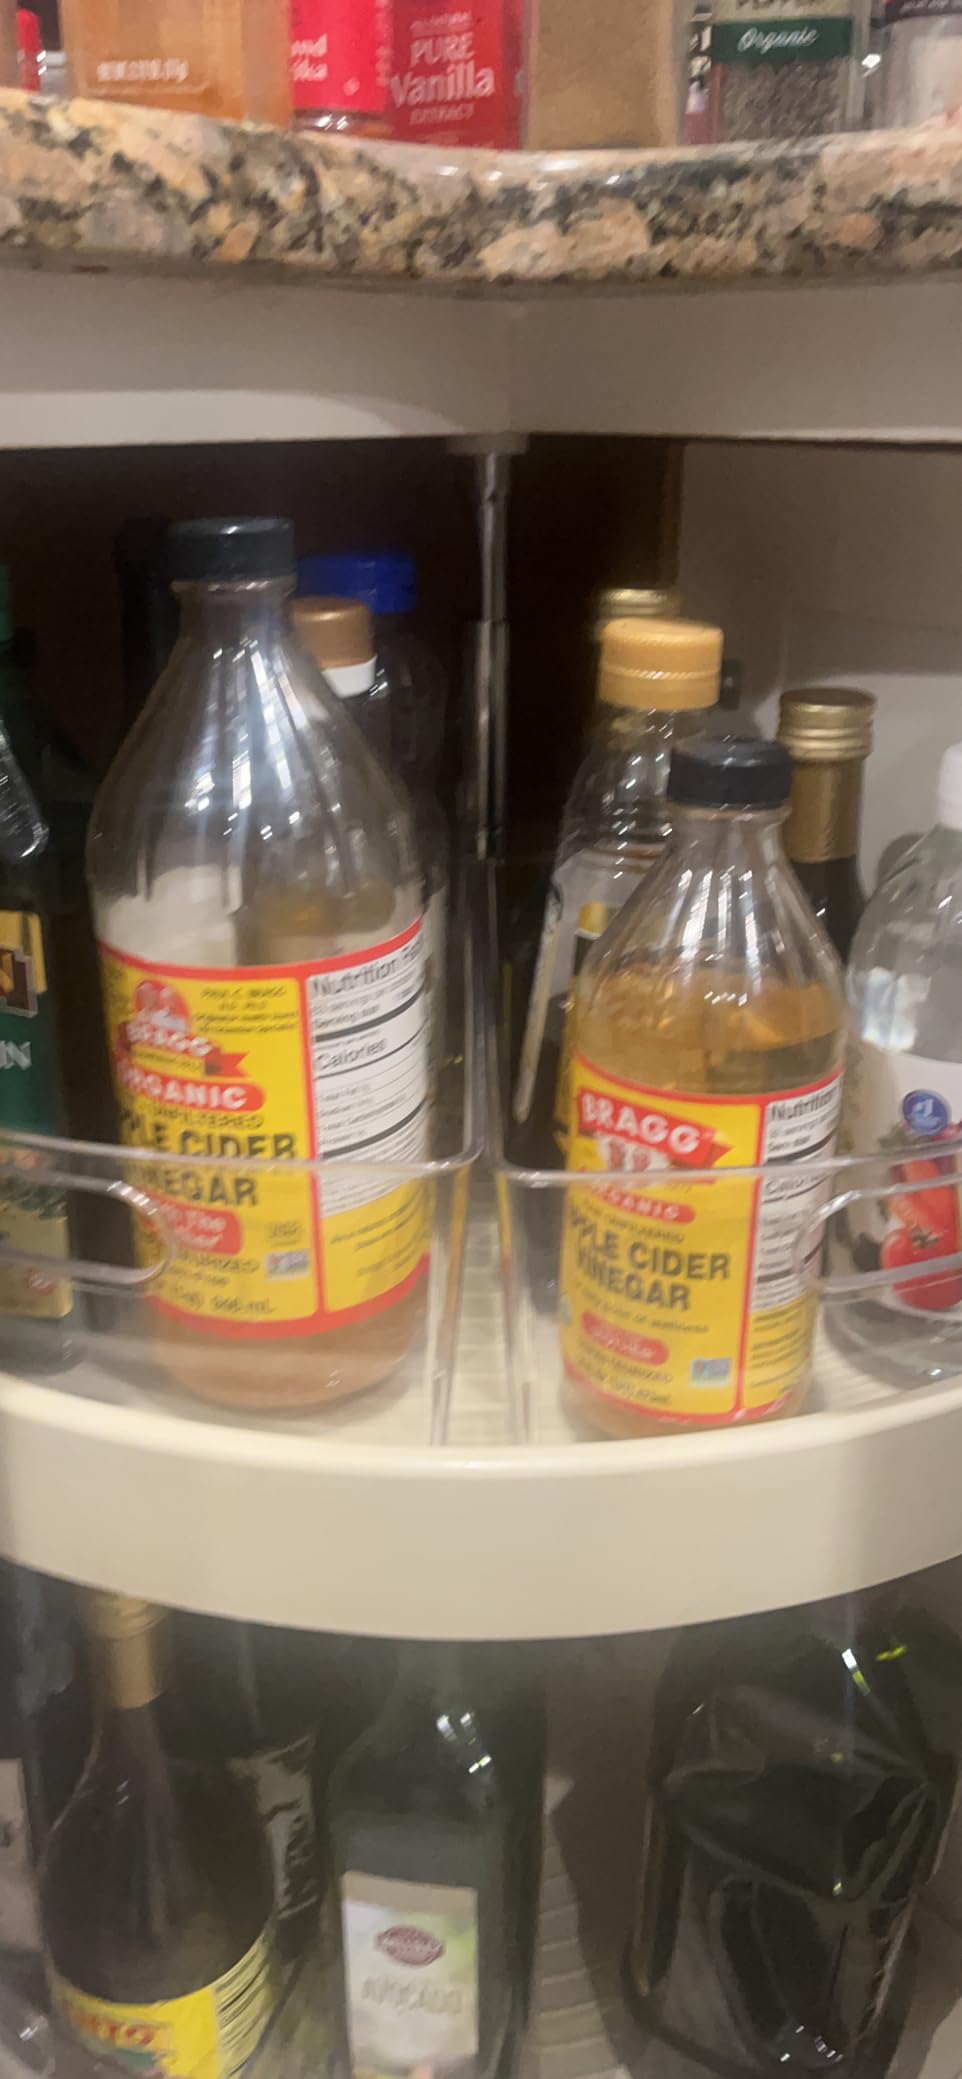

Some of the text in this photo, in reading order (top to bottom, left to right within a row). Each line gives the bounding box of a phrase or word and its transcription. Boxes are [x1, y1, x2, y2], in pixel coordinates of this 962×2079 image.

[410, 32, 474, 68] PURE
[737, 27, 818, 54] Organic
[390, 60, 495, 108] Vanilla
[312, 957, 396, 996] Nutrition
[318, 1038, 386, 1071] Calories
[580, 1093, 701, 1154] BRAGG
[178, 1129, 297, 1159] CIDER
[628, 1241, 730, 1282] CIDER
